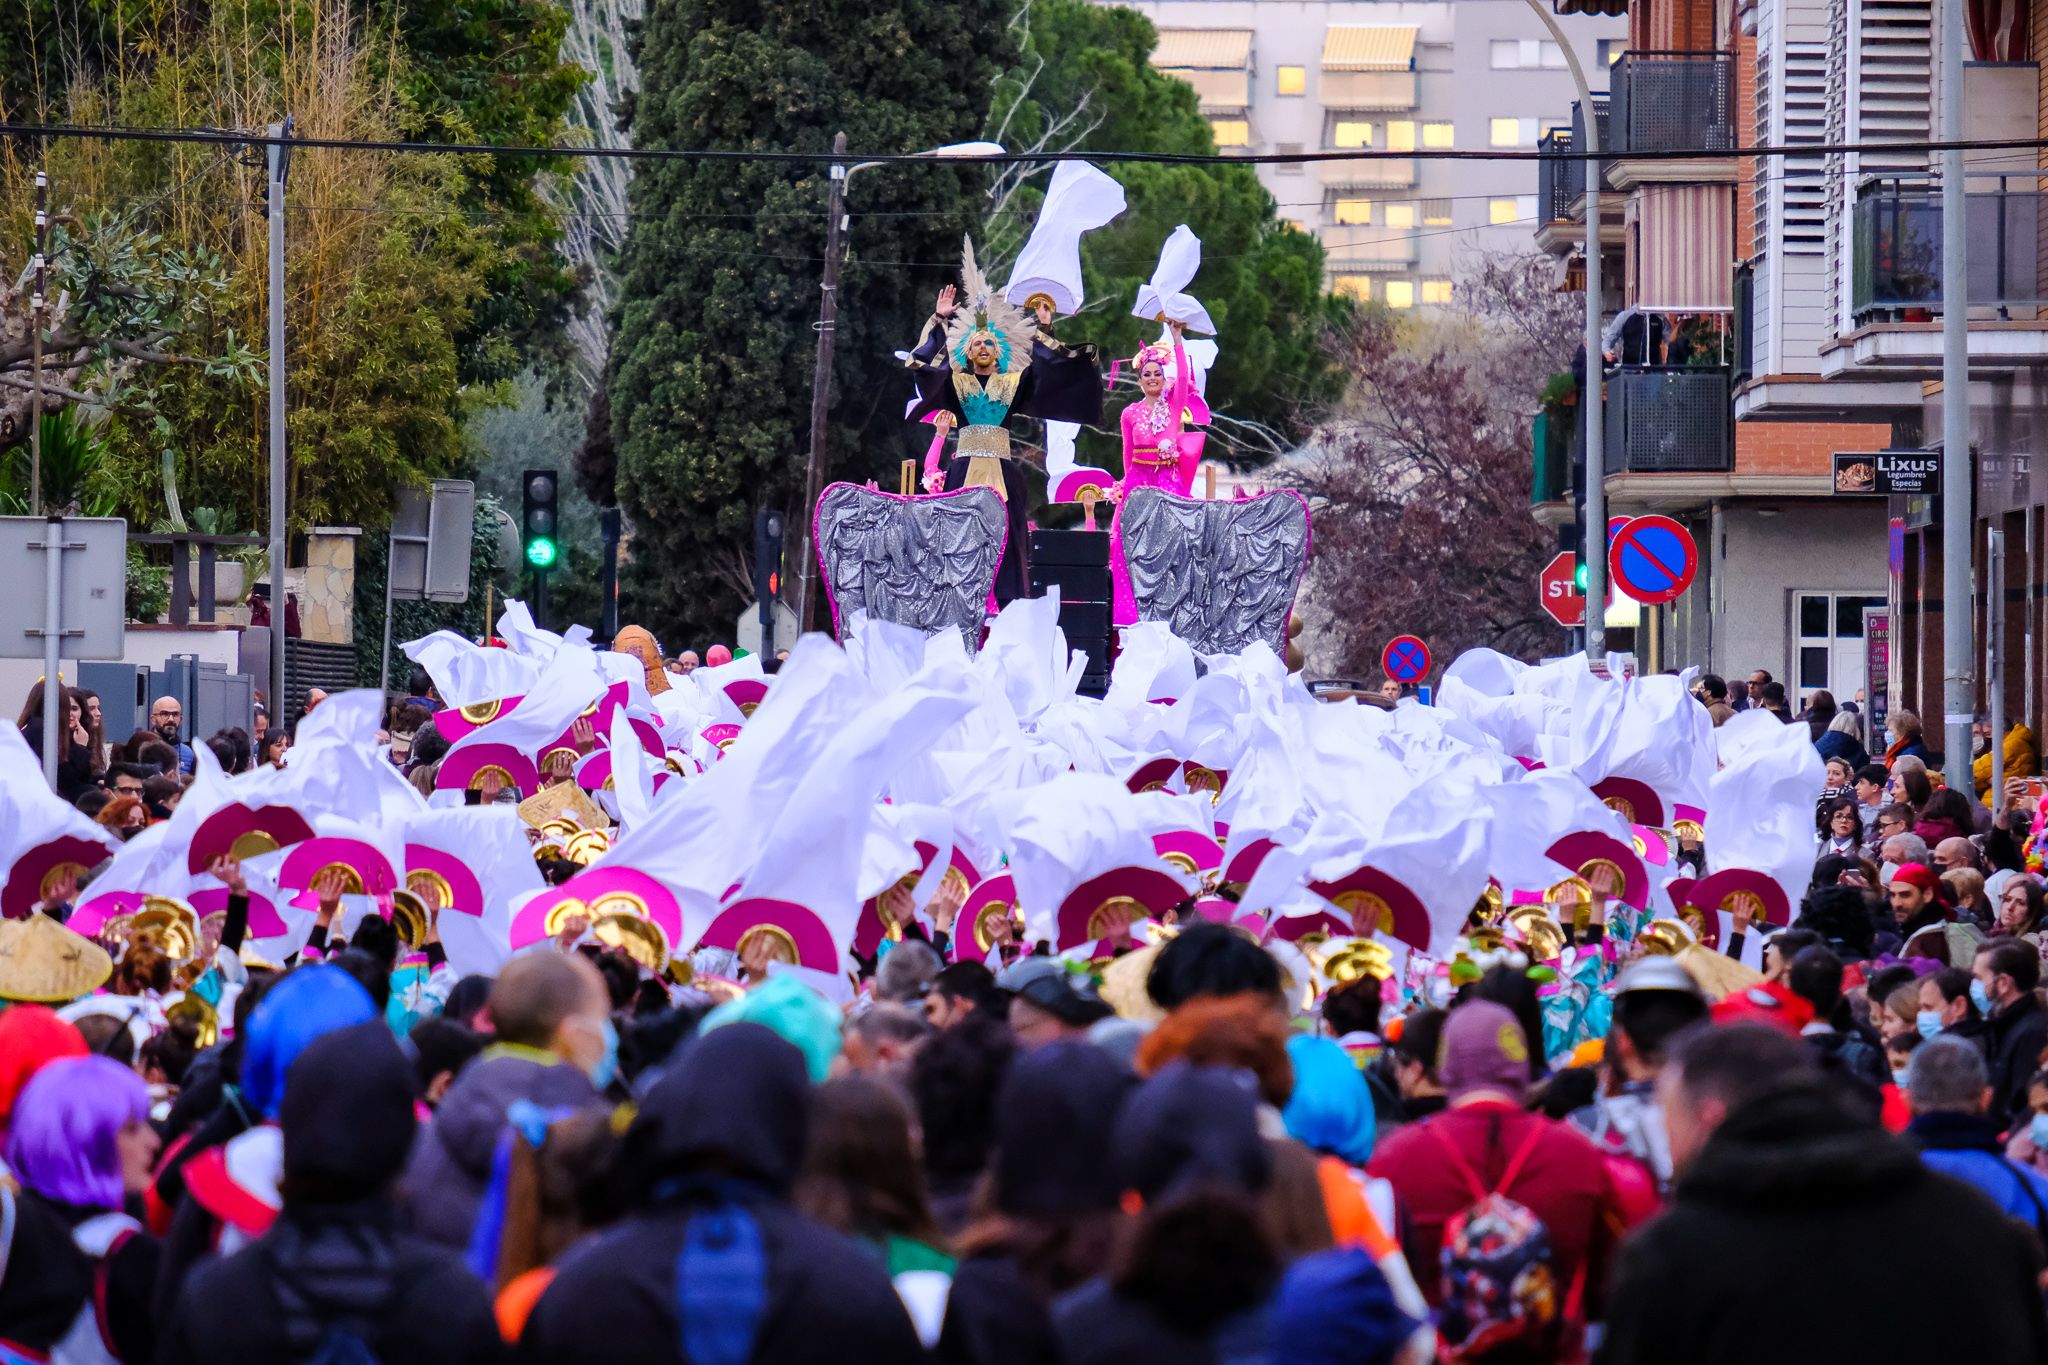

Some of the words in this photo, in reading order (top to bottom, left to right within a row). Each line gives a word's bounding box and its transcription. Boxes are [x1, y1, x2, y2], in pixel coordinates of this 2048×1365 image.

[1877, 456, 1938, 472] Lixus
[1887, 471, 1927, 480] Legumbres
[1891, 479, 1922, 488] Especias
[1548, 580, 1577, 598] ST
